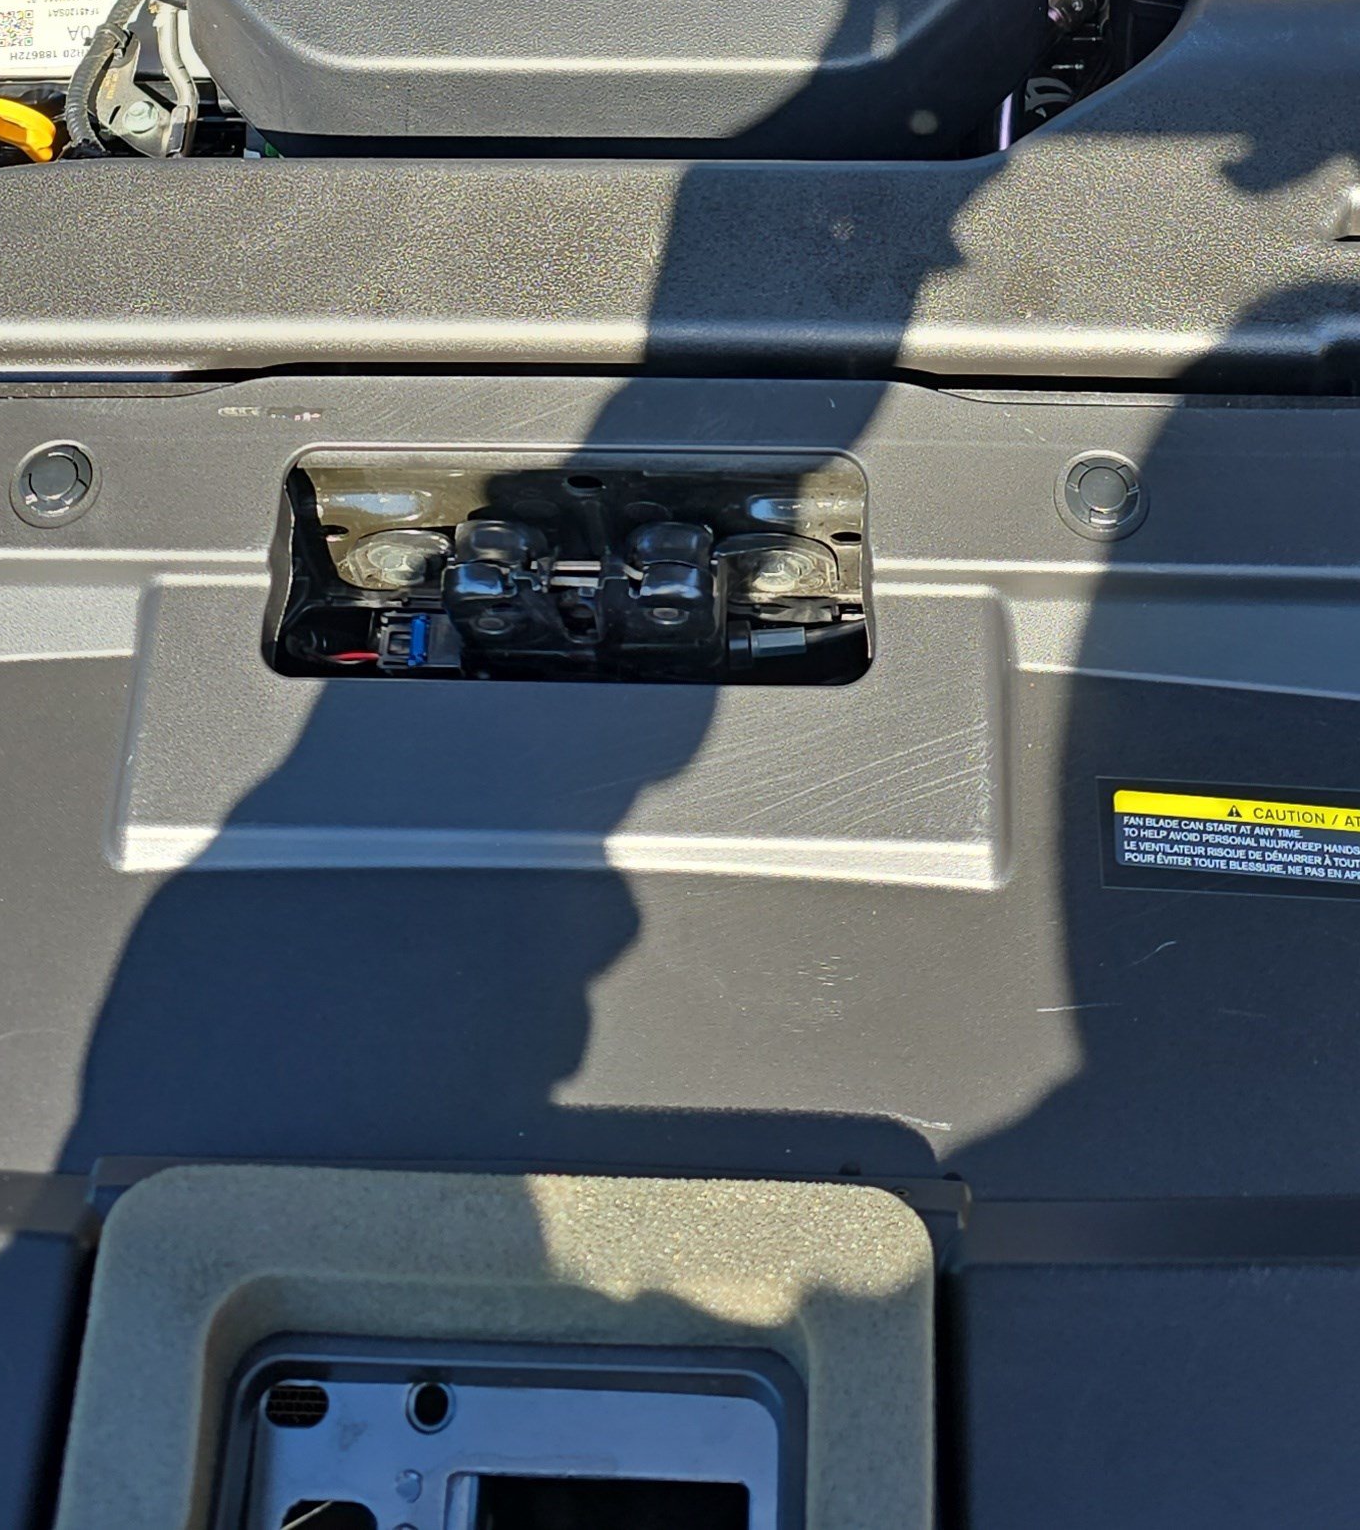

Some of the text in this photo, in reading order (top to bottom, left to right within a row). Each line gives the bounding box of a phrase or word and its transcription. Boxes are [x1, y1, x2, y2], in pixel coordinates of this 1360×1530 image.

[1123, 816, 1303, 839] FAN BLADE CAN START AT ANY TIME.
[1253, 807, 1326, 824] CAUTION
[1332, 814, 1339, 825] /
[1123, 828, 1138, 837] TO
[1140, 829, 1167, 838] HELP
[1168, 831, 1200, 842] AVOID
[1202, 834, 1257, 846] PERSONAL
[1323, 844, 1360, 856] HANDS
[1124, 841, 1137, 850] LE
[1139, 841, 1205, 855] VENTILATEUR
[1207, 847, 1246, 859] RISQUE
[1248, 850, 1262, 860] DE
[1265, 850, 1322, 865] DÉMARRER
[1323, 854, 1332, 866] À
[1333, 857, 1360, 868] TOUT
[1124, 852, 1155, 863] POUR
[1157, 853, 1192, 866] ÉVITER
[1193, 857, 1228, 869] TOUTE
[1229, 860, 1286, 875] BLESSURE,
[1288, 865, 1303, 875] NE
[1304, 867, 1326, 878] PAS
[1327, 869, 1341, 879] EN
